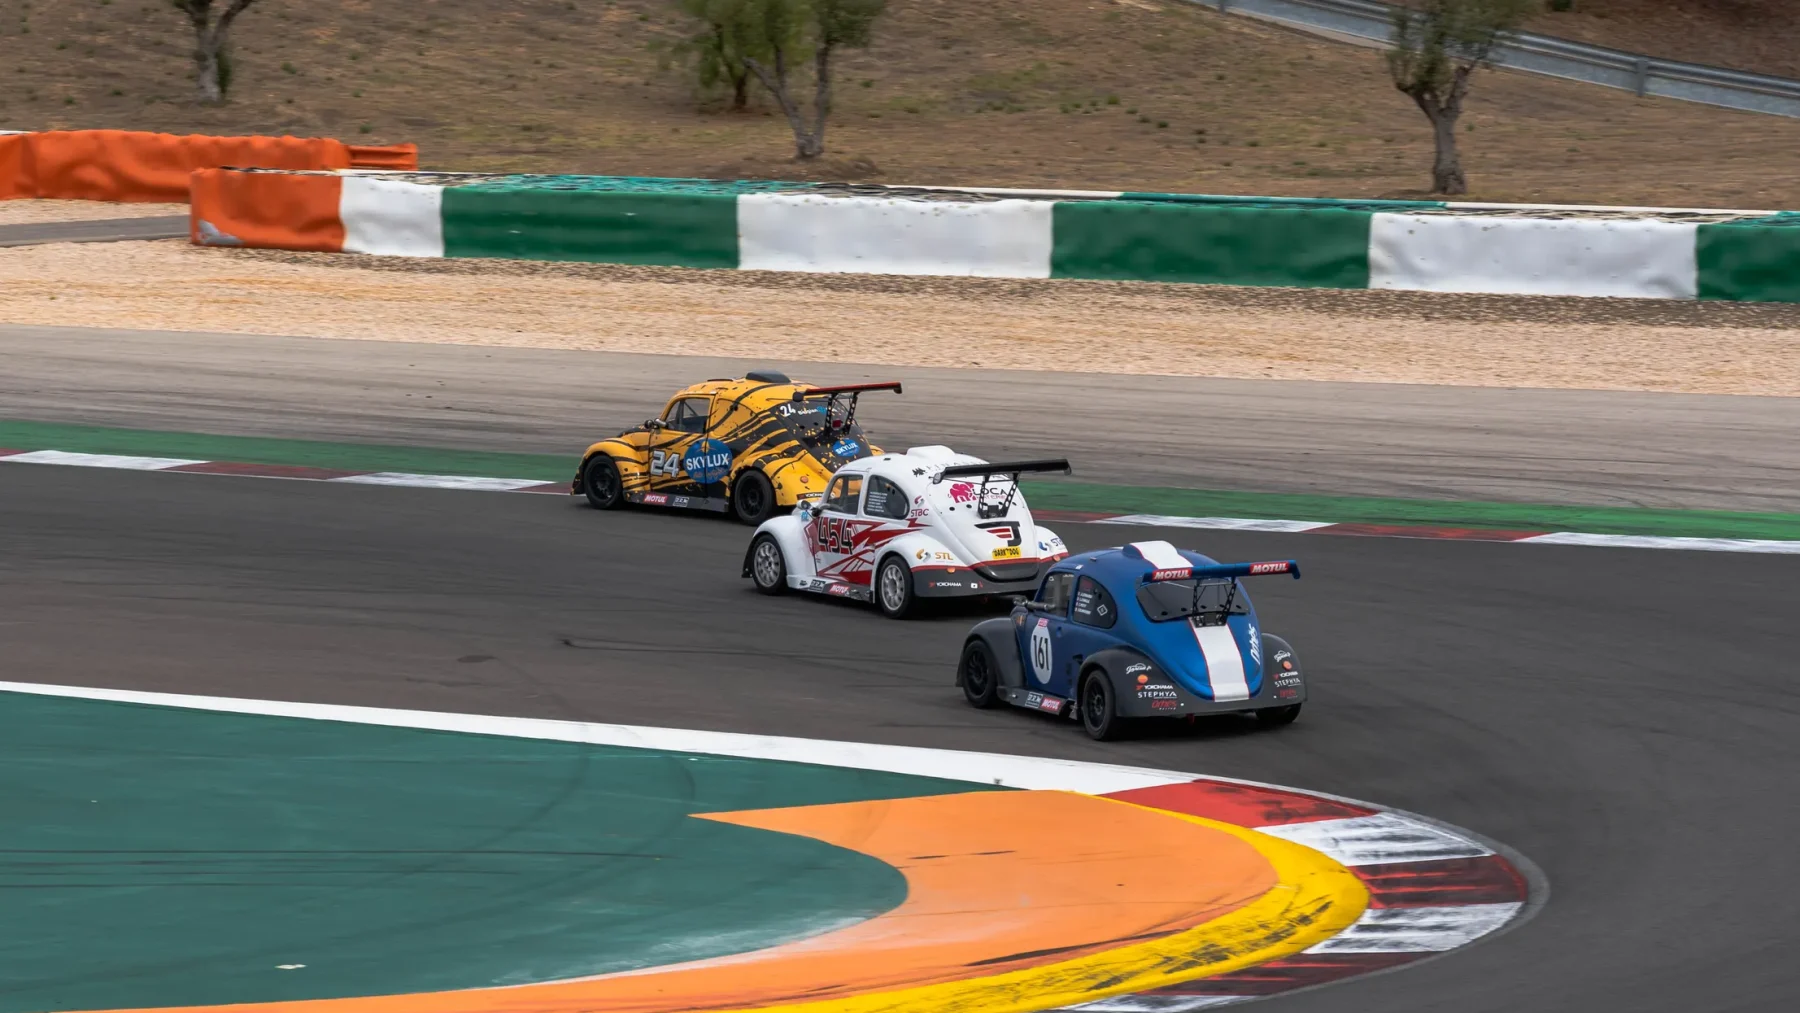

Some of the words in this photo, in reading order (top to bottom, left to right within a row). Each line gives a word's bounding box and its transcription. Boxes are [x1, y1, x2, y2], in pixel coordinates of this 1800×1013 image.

[780, 403, 796, 418] 24
[835, 441, 859, 455] SKYLUX
[650, 450, 680, 478] 24
[686, 453, 729, 471] SKYLUX
[644, 494, 667, 503] MOTUL
[818, 517, 853, 556] 454
[935, 551, 954, 561] STL
[1252, 562, 1288, 573] MOTUL
[1153, 569, 1190, 581] MOTUL
[1033, 634, 1050, 671] 161
[1137, 691, 1178, 699] STEPHYA
[1041, 697, 1060, 710] MOTUL
